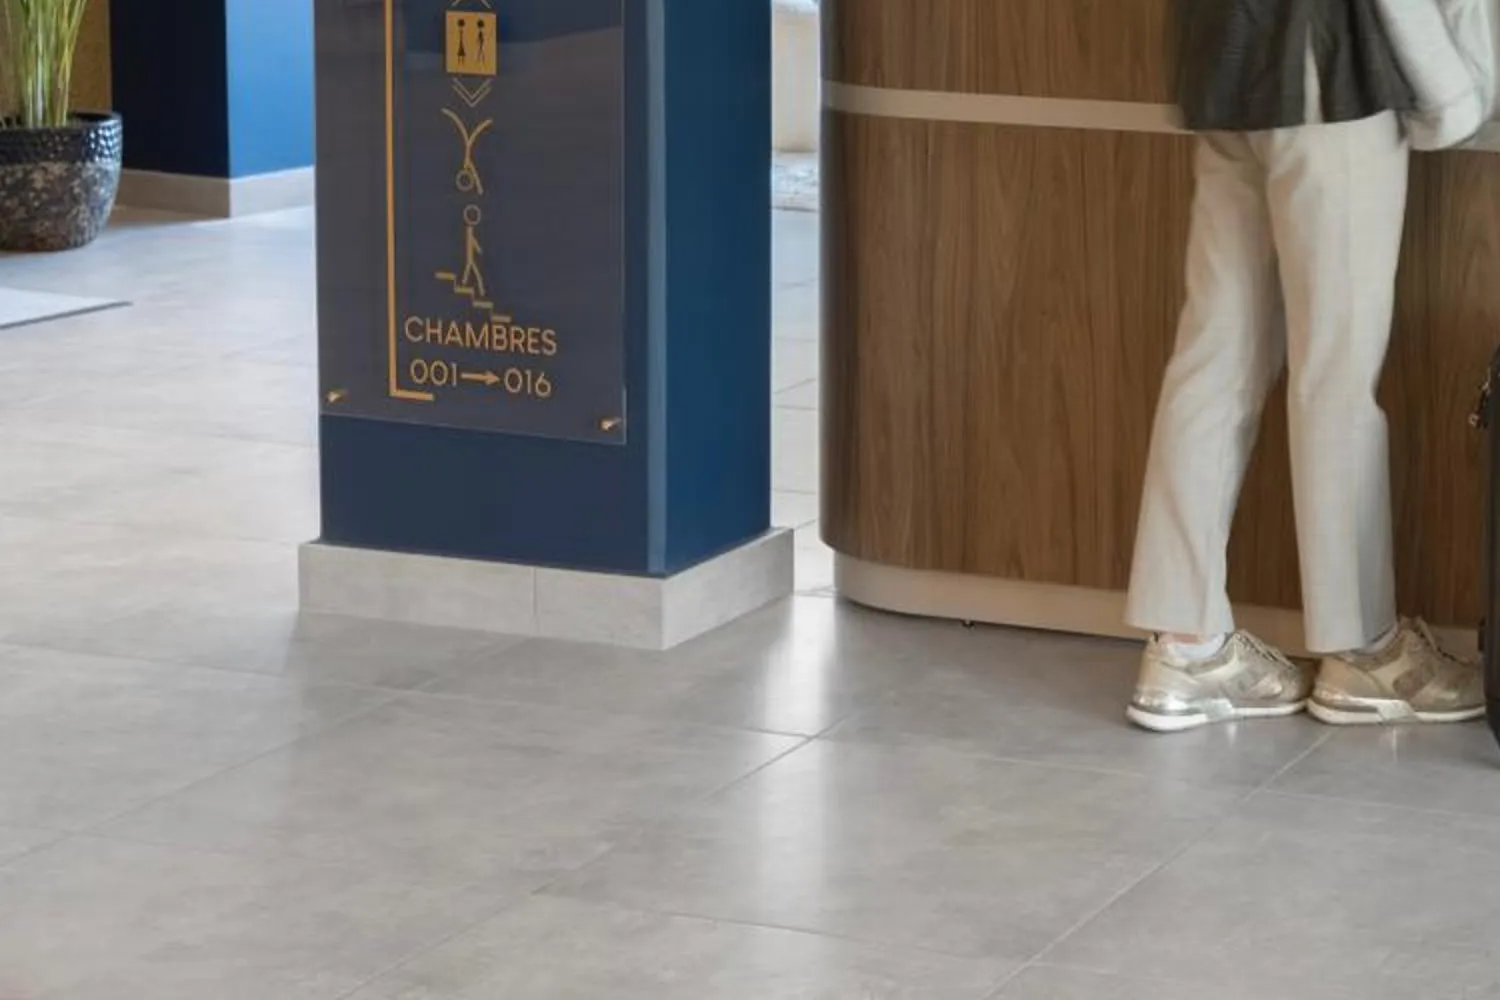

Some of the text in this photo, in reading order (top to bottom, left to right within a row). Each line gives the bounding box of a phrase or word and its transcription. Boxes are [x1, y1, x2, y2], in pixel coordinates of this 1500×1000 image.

[404, 315, 558, 356] CHAMBRES
[409, 358, 552, 398] 001 016
